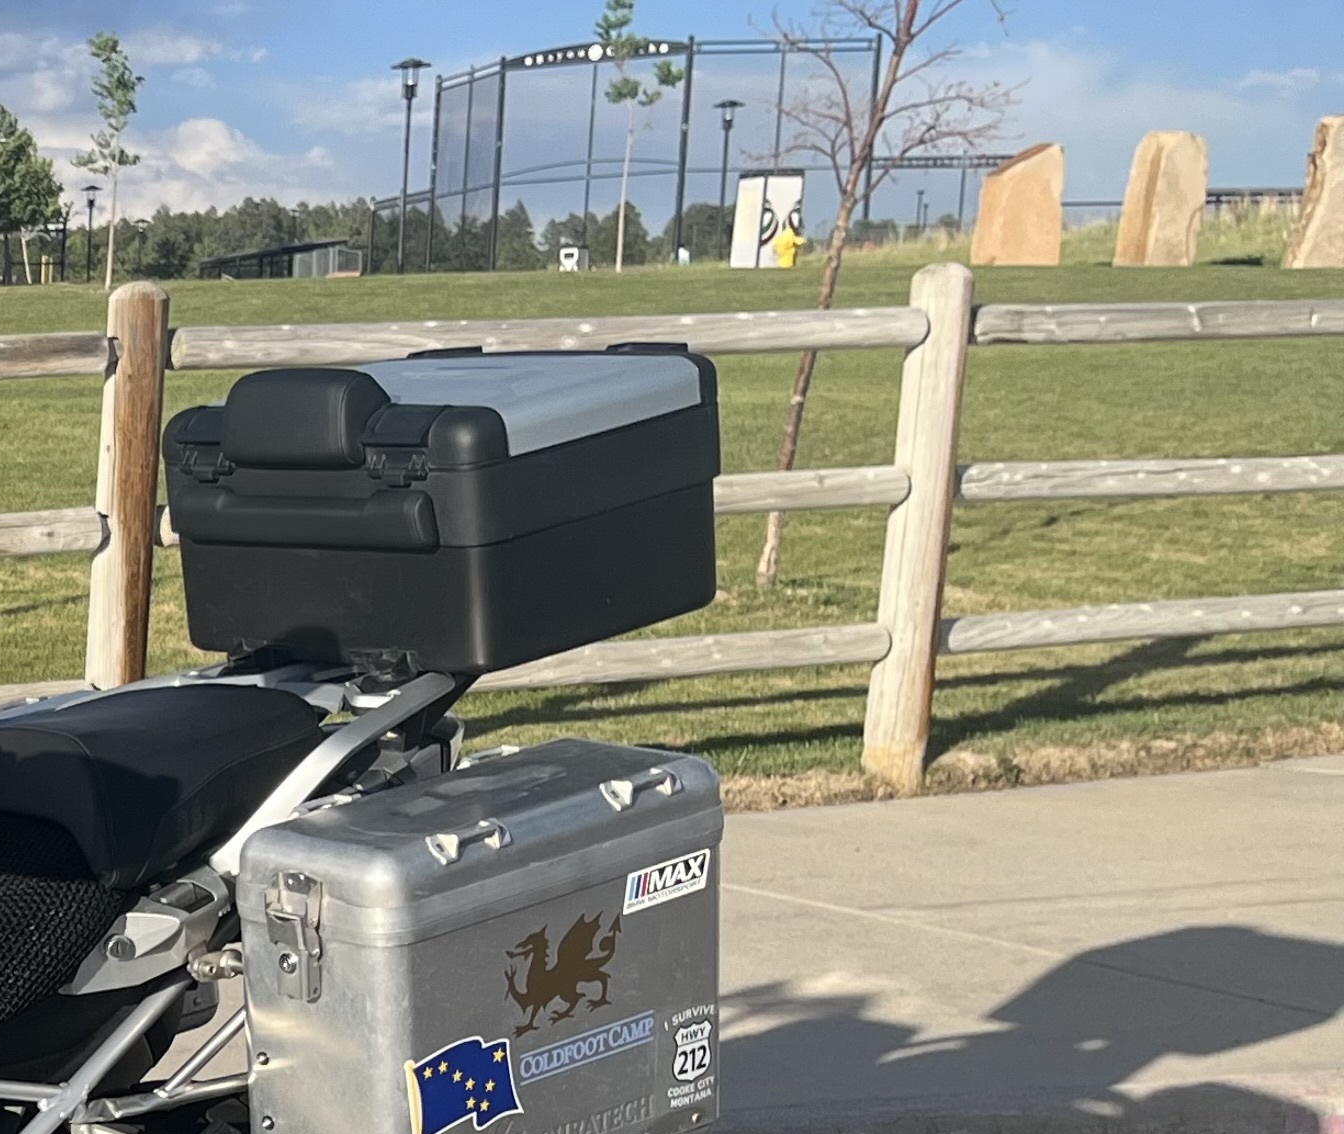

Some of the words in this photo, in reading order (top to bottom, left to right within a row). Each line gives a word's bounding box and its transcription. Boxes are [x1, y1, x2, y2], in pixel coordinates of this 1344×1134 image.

[648, 855, 704, 893] MAX
[680, 1027, 706, 1041] HWY
[520, 1033, 609, 1078] COLDFOOT
[609, 1017, 654, 1047] CAMP
[677, 1045, 707, 1076] 212
[697, 1076, 715, 1091] CITY
[670, 1088, 712, 1109] MONTANA
